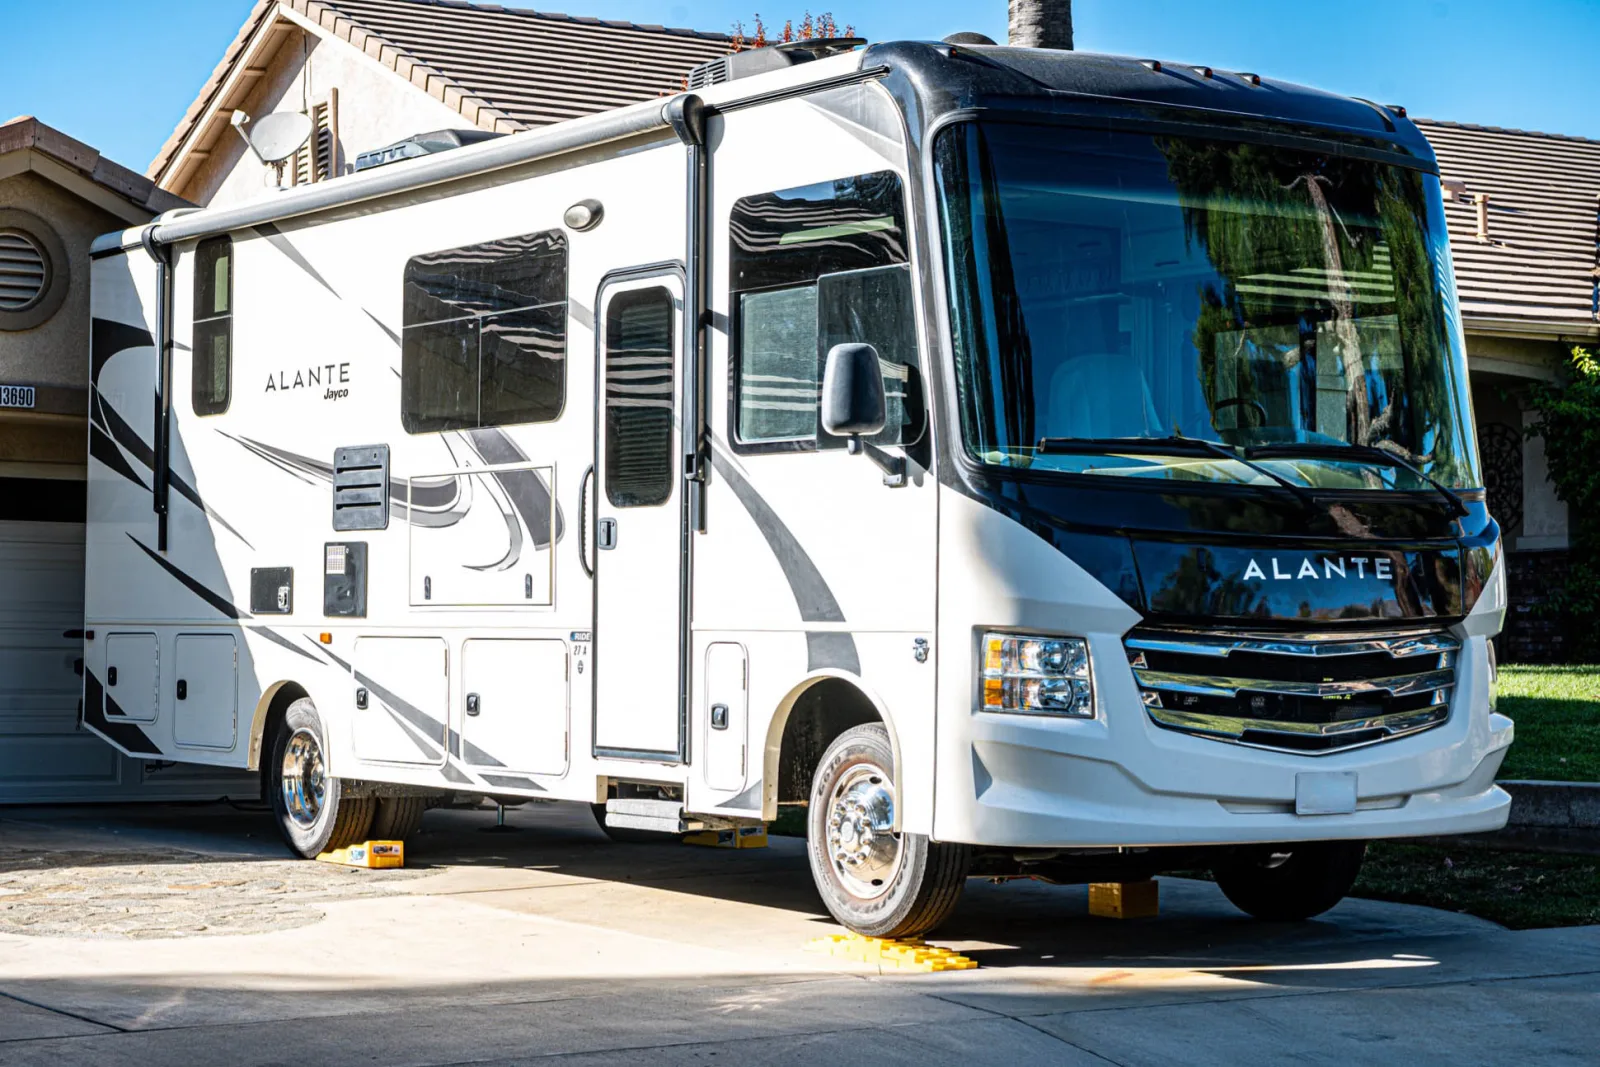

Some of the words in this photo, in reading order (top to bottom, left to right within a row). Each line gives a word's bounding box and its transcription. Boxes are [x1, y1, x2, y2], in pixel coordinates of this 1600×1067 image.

[265, 362, 350, 392] ALANTE
[323, 388, 349, 401] Jayco
[1243, 557, 1393, 580] ALANTE
